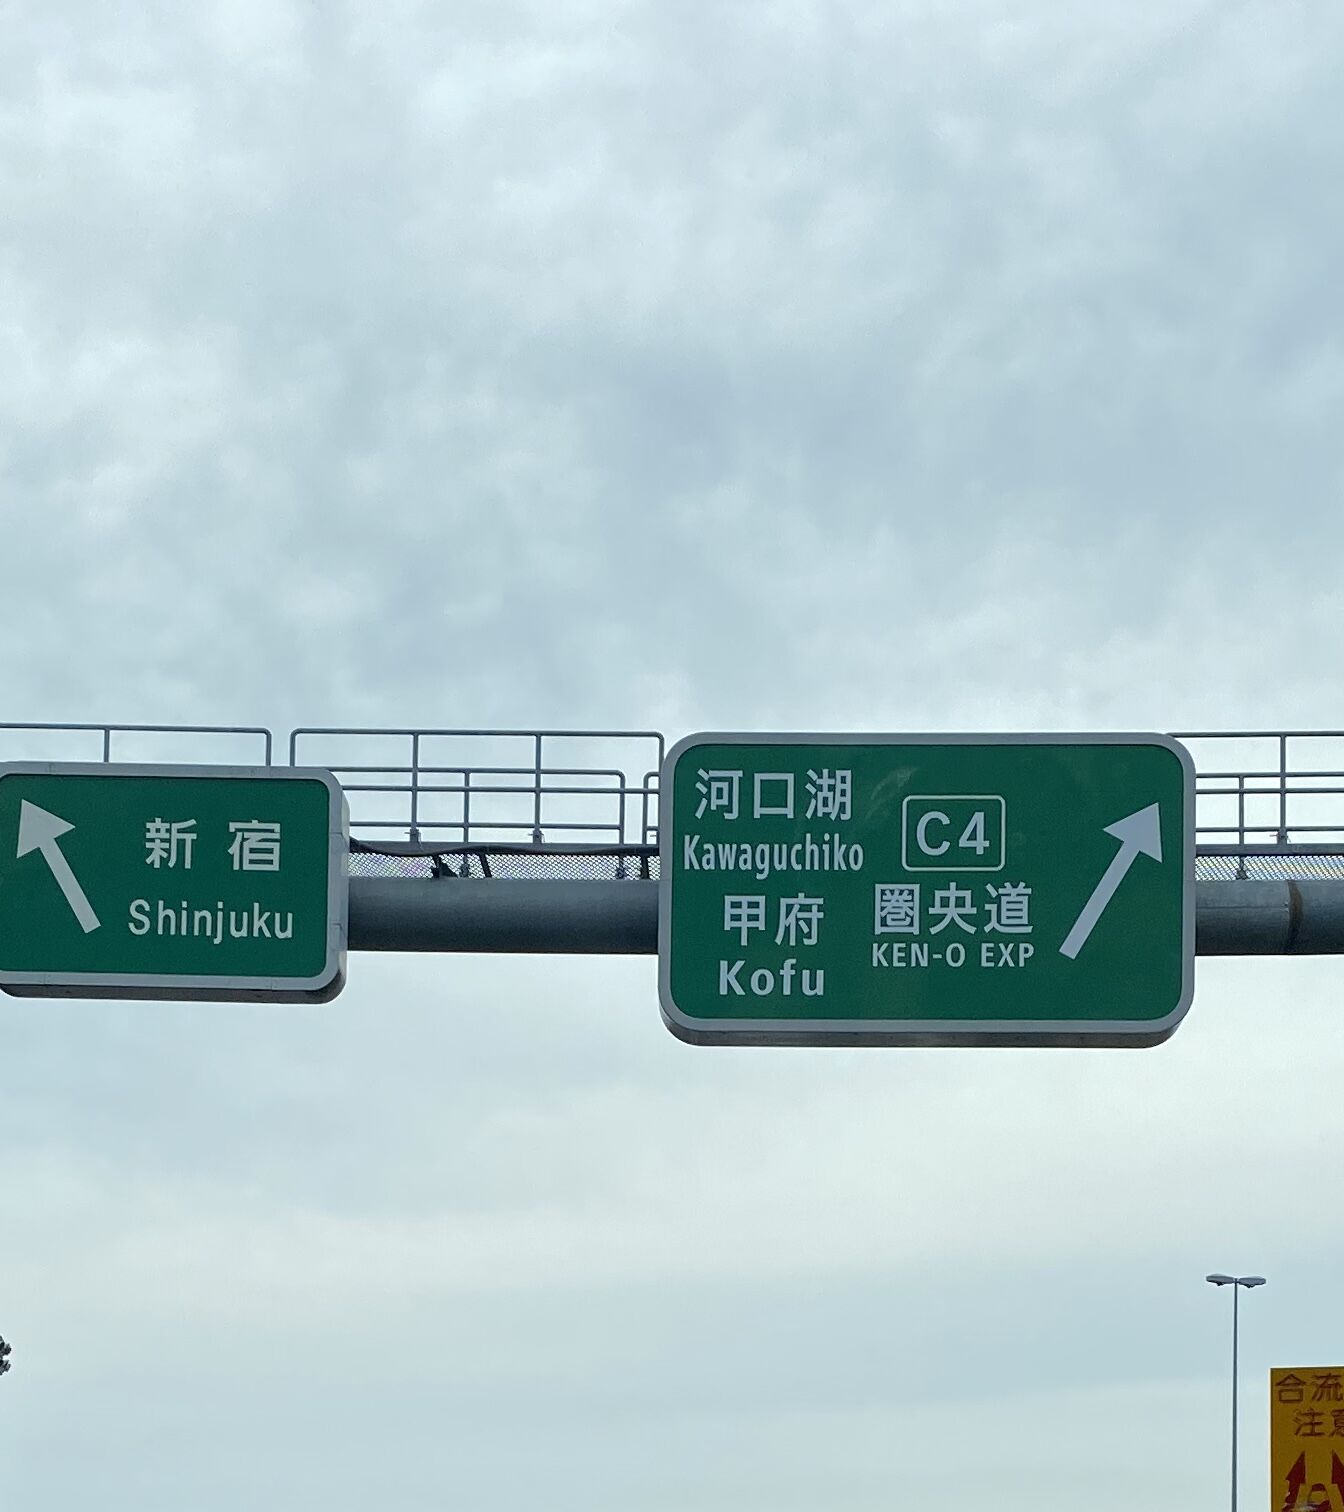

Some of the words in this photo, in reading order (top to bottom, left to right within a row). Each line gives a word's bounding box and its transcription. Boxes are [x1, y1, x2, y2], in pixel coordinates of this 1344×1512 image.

[695, 768, 852, 821] 河口湖
[145, 817, 281, 871] 新宿
[916, 810, 990, 856] C4
[683, 834, 864, 879] Kawaguchiko
[128, 899, 294, 945] Shinjuku
[723, 894, 825, 946] 甲府
[873, 882, 1034, 935] 圏央道
[719, 959, 825, 996] Kofu
[872, 942, 966, 968] KEN-O
[981, 943, 1035, 968] EXP
[1275, 1373, 1344, 1402] 合流
